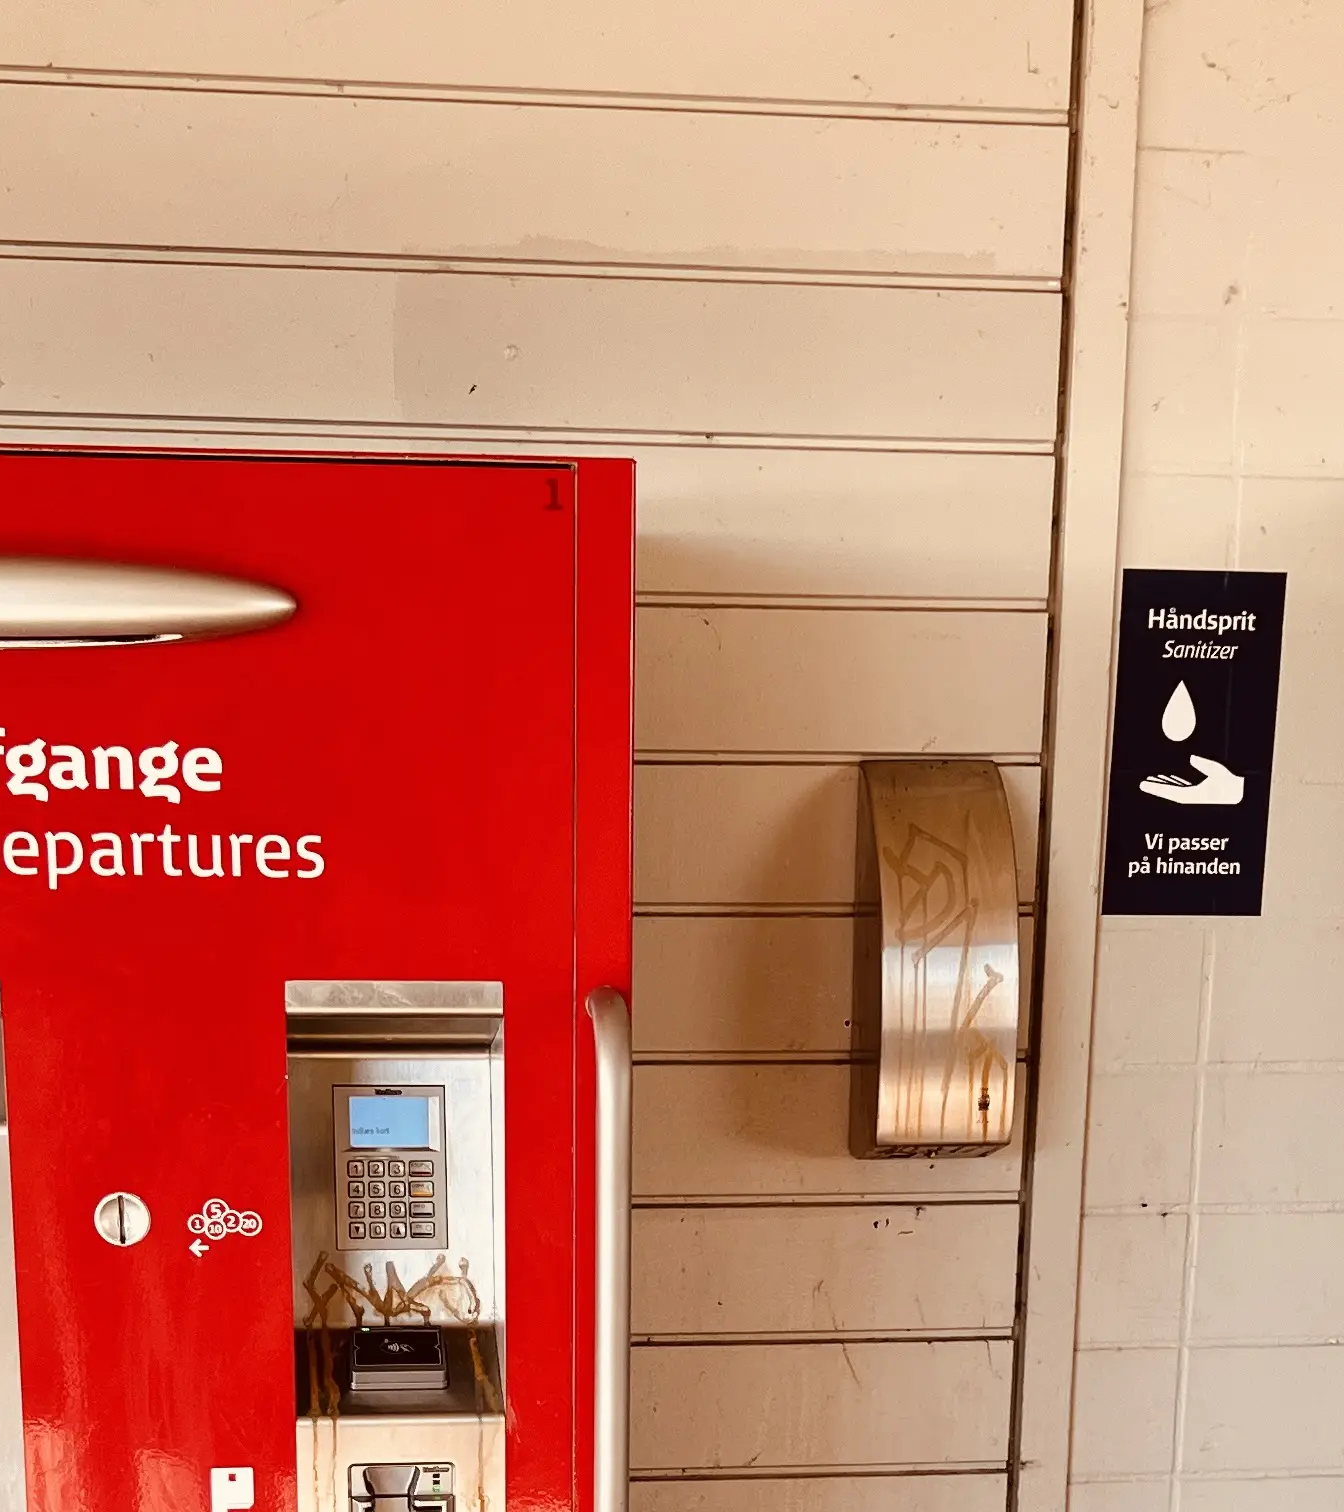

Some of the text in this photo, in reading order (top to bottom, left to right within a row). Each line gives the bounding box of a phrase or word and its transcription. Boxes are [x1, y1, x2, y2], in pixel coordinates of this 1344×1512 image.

[544, 478, 564, 511] 1
[1147, 607, 1256, 635] Håndsprit
[1162, 640, 1238, 660] Sanitizer
[1145, 833, 1229, 853] Vi passer
[1128, 855, 1241, 877] på hinanden
[372, 1164, 380, 1174] 2
[393, 1164, 401, 1174] 3
[353, 1184, 360, 1194] 4
[372, 1185, 380, 1194] 5
[394, 1185, 401, 1195] 6
[210, 1203, 222, 1219] 5
[353, 1205, 360, 1215] 7
[374, 1205, 381, 1215] 8
[394, 1205, 401, 1215] 9
[194, 1219, 201, 1229] 1
[226, 1215, 236, 1227] 2
[242, 1218, 257, 1229] 20
